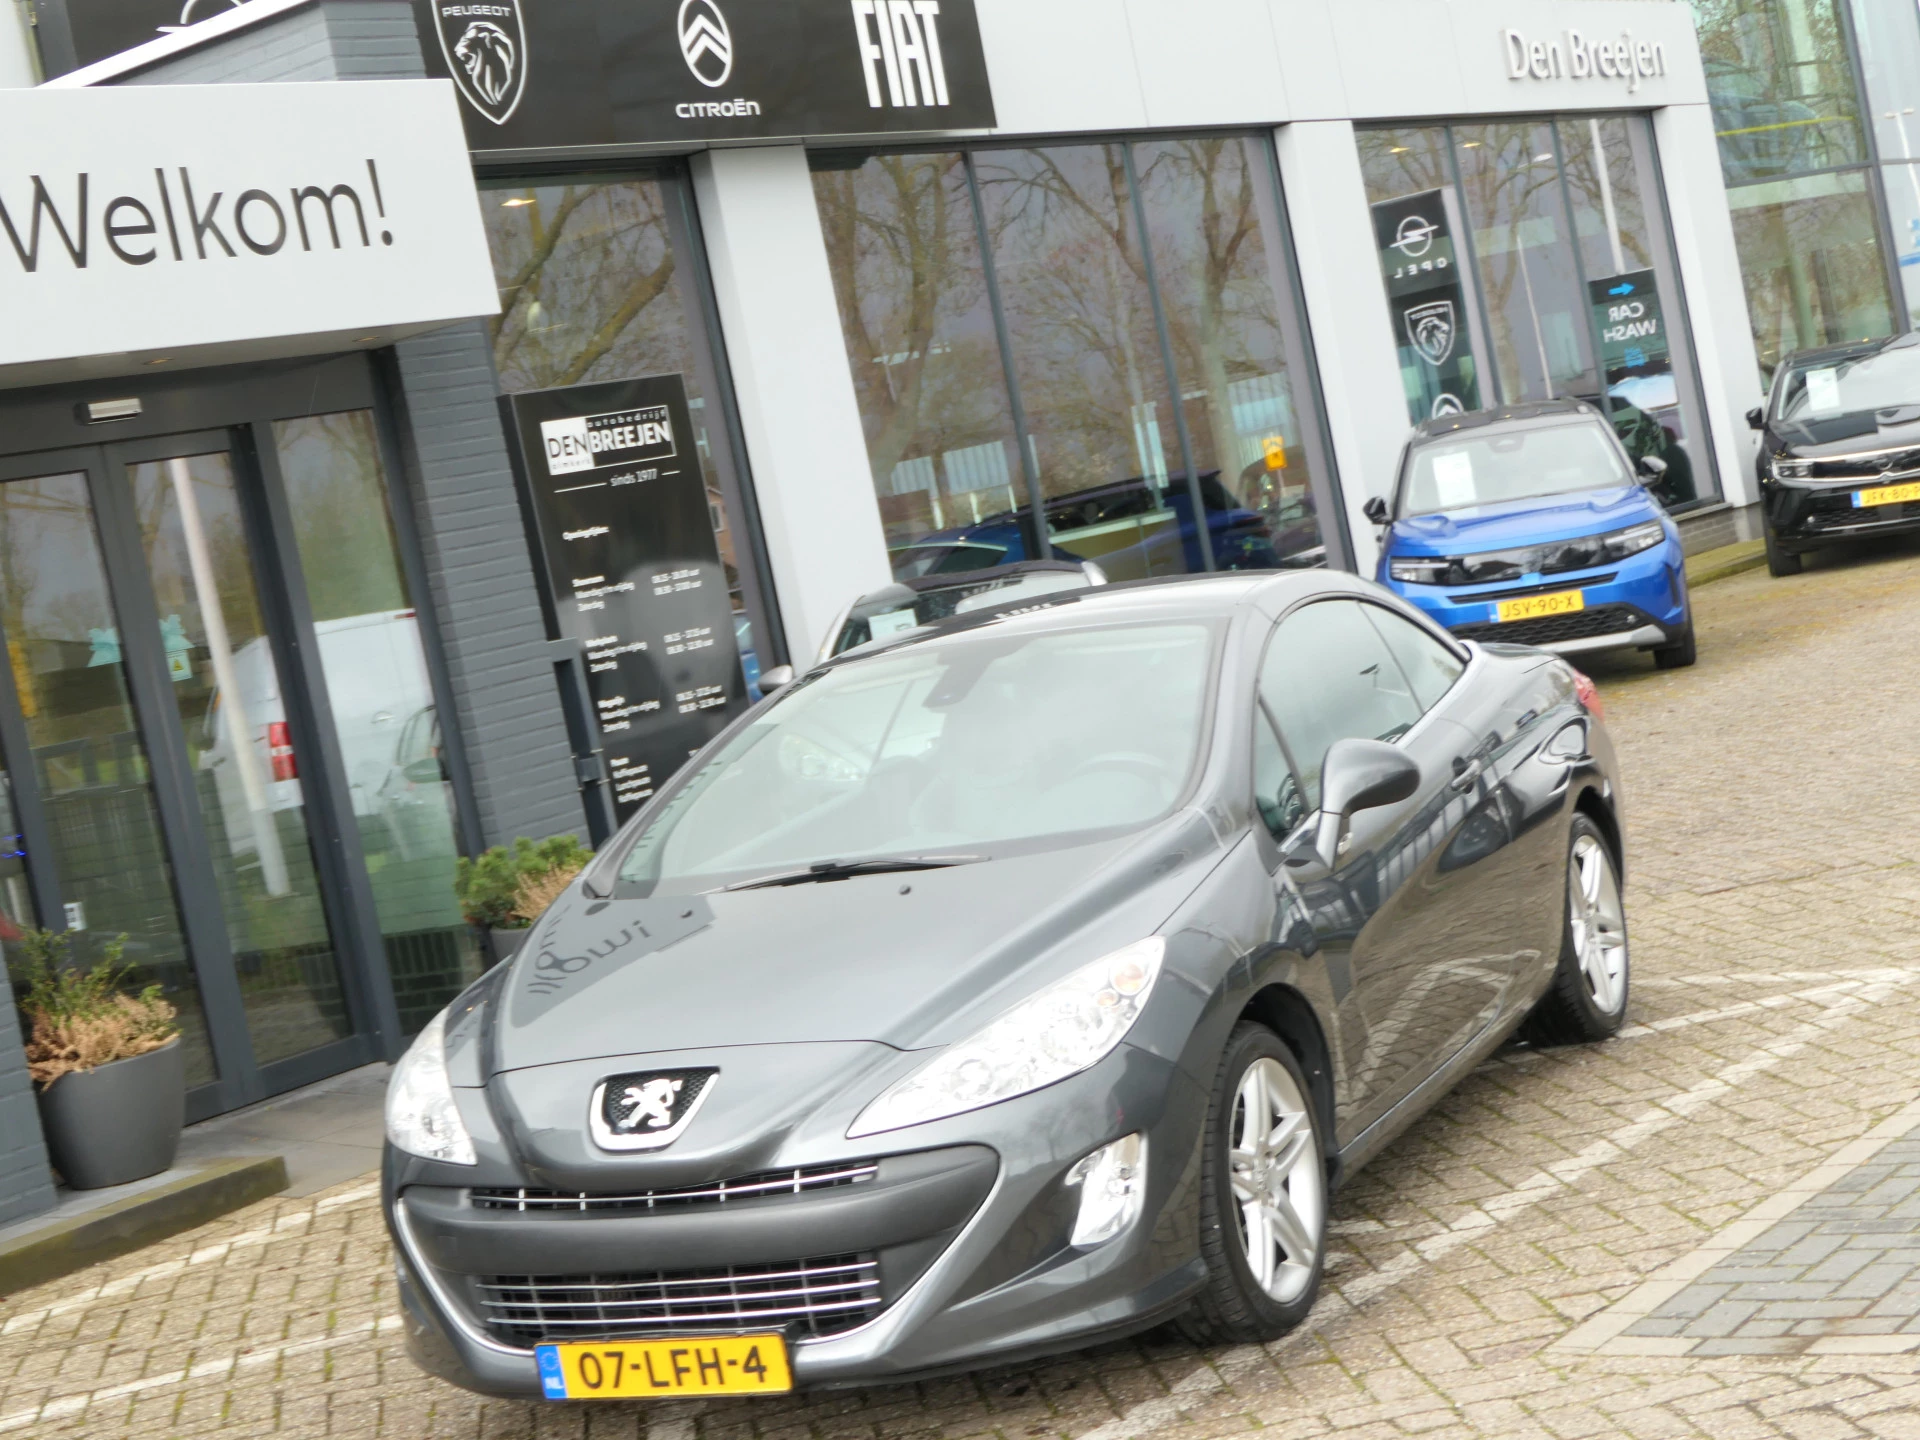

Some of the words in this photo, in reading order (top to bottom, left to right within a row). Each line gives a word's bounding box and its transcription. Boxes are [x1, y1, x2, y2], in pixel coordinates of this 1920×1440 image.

[441, 5, 511, 17] PEUGEOT
[850, 0, 950, 108] FIAT
[1499, 28, 1565, 80] Den
[1563, 28, 1668, 94] Breejen
[0, 159, 393, 273] Welkom!
[586, 408, 667, 429] autobedrijf
[588, 420, 672, 454] BREEJEN
[609, 472, 637, 487] sinds
[635, 468, 658, 483] 1977
[1503, 595, 1575, 618] JSV-90-X
[578, 1345, 768, 1391] 07-LFH-4
